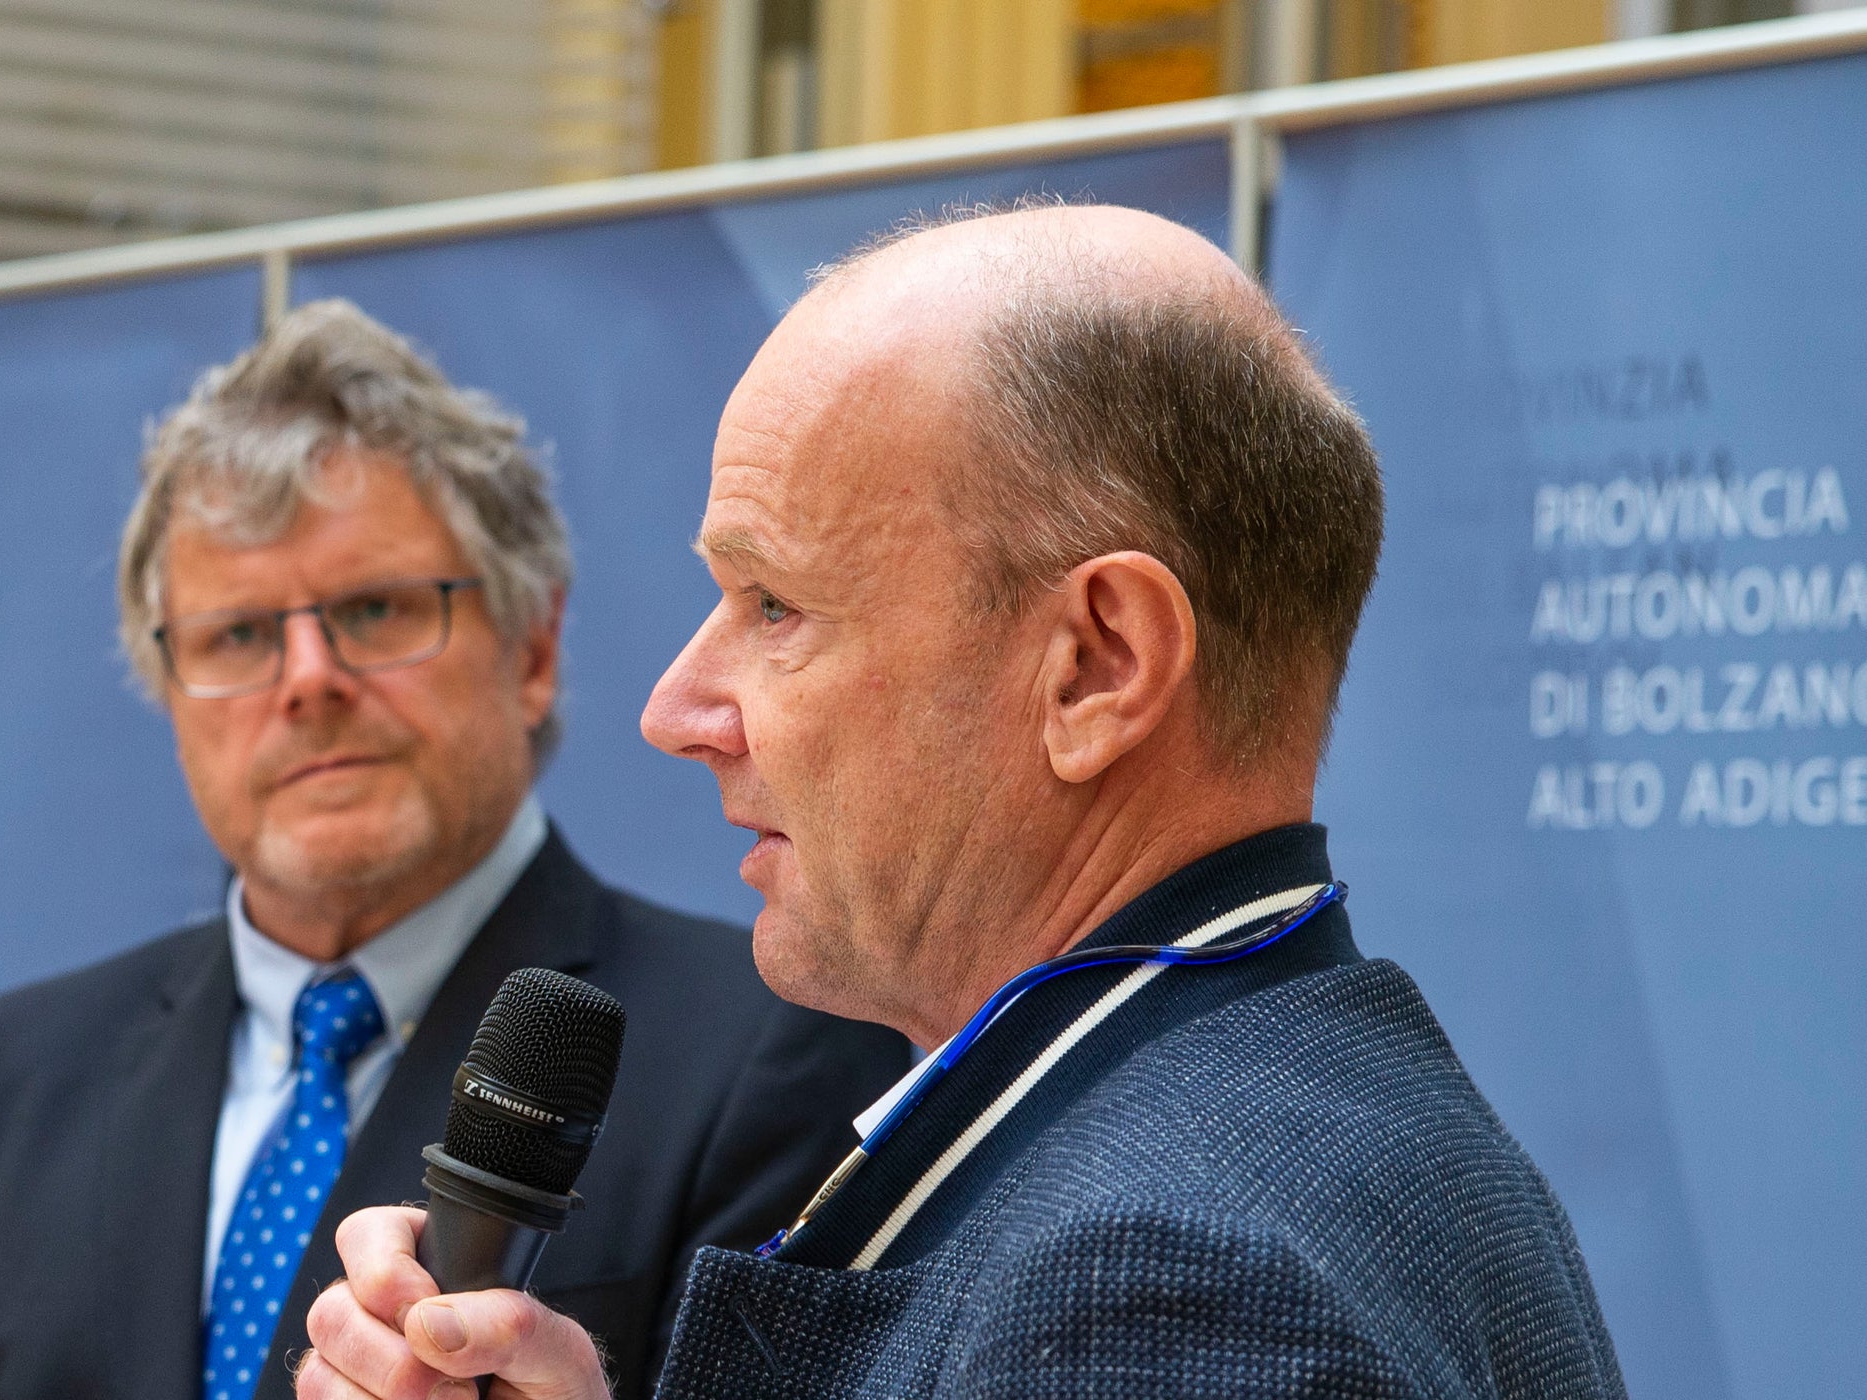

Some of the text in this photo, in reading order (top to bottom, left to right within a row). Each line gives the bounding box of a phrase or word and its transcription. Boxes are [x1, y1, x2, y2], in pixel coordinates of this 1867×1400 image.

[1535, 467, 1849, 550] PROVINCIA
[1533, 563, 1867, 644] AUTONOMA
[1531, 670, 1589, 738] DI
[1528, 757, 1867, 830] ALTO ADIGE
